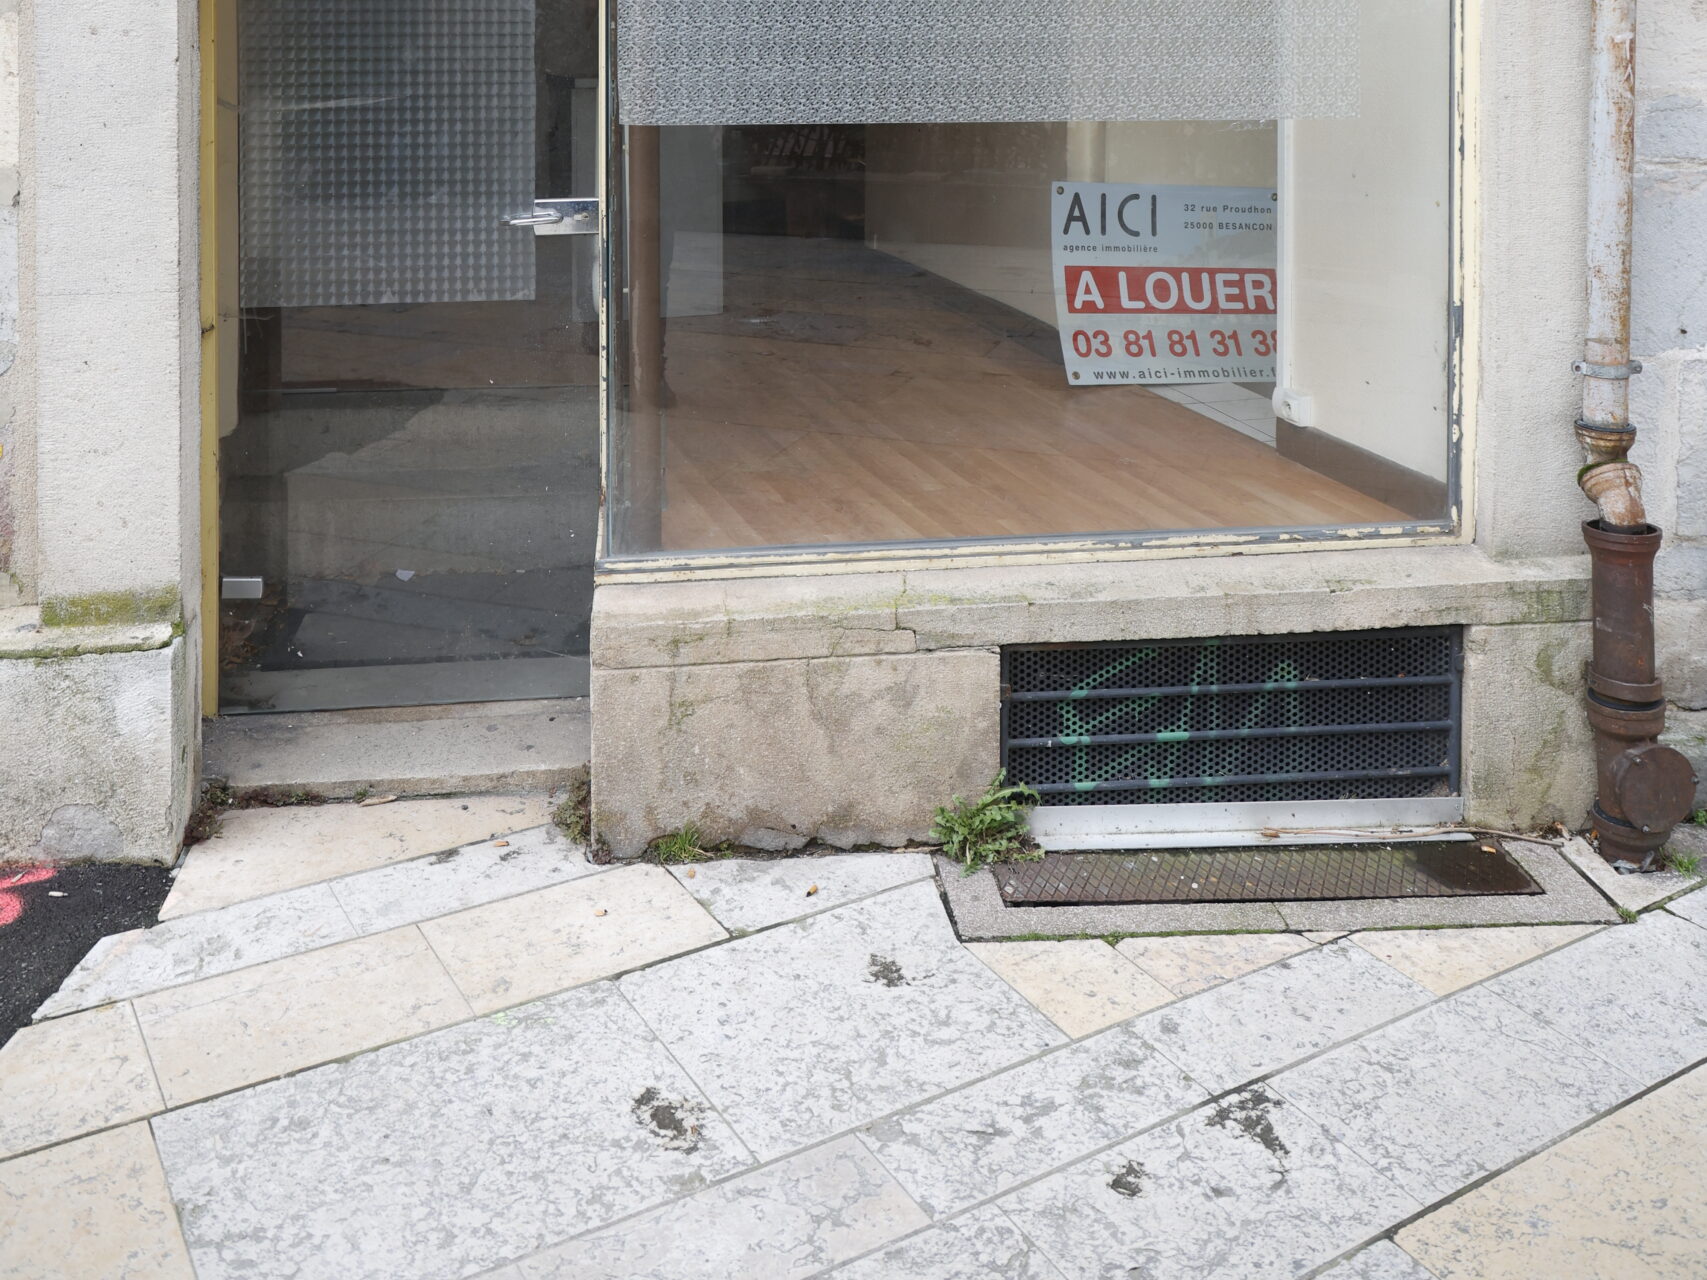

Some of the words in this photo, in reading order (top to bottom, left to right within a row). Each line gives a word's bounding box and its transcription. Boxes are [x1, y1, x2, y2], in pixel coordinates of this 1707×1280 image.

[1062, 192, 1158, 238] AICI
[1183, 203, 1196, 213] 32
[1201, 205, 1218, 213] rue
[1222, 204, 1273, 215] Proudhon
[1183, 221, 1214, 231] 25000
[1218, 222, 1273, 232] BESANCON
[1062, 244, 1097, 253] agence
[1101, 244, 1159, 253] immobilière
[1074, 270, 1105, 310] A
[1118, 270, 1276, 311] LOUER
[1072, 329, 1113, 358] 03
[1122, 329, 1158, 358] 81
[1167, 329, 1201, 358] 81
[1209, 329, 1243, 358] 31
